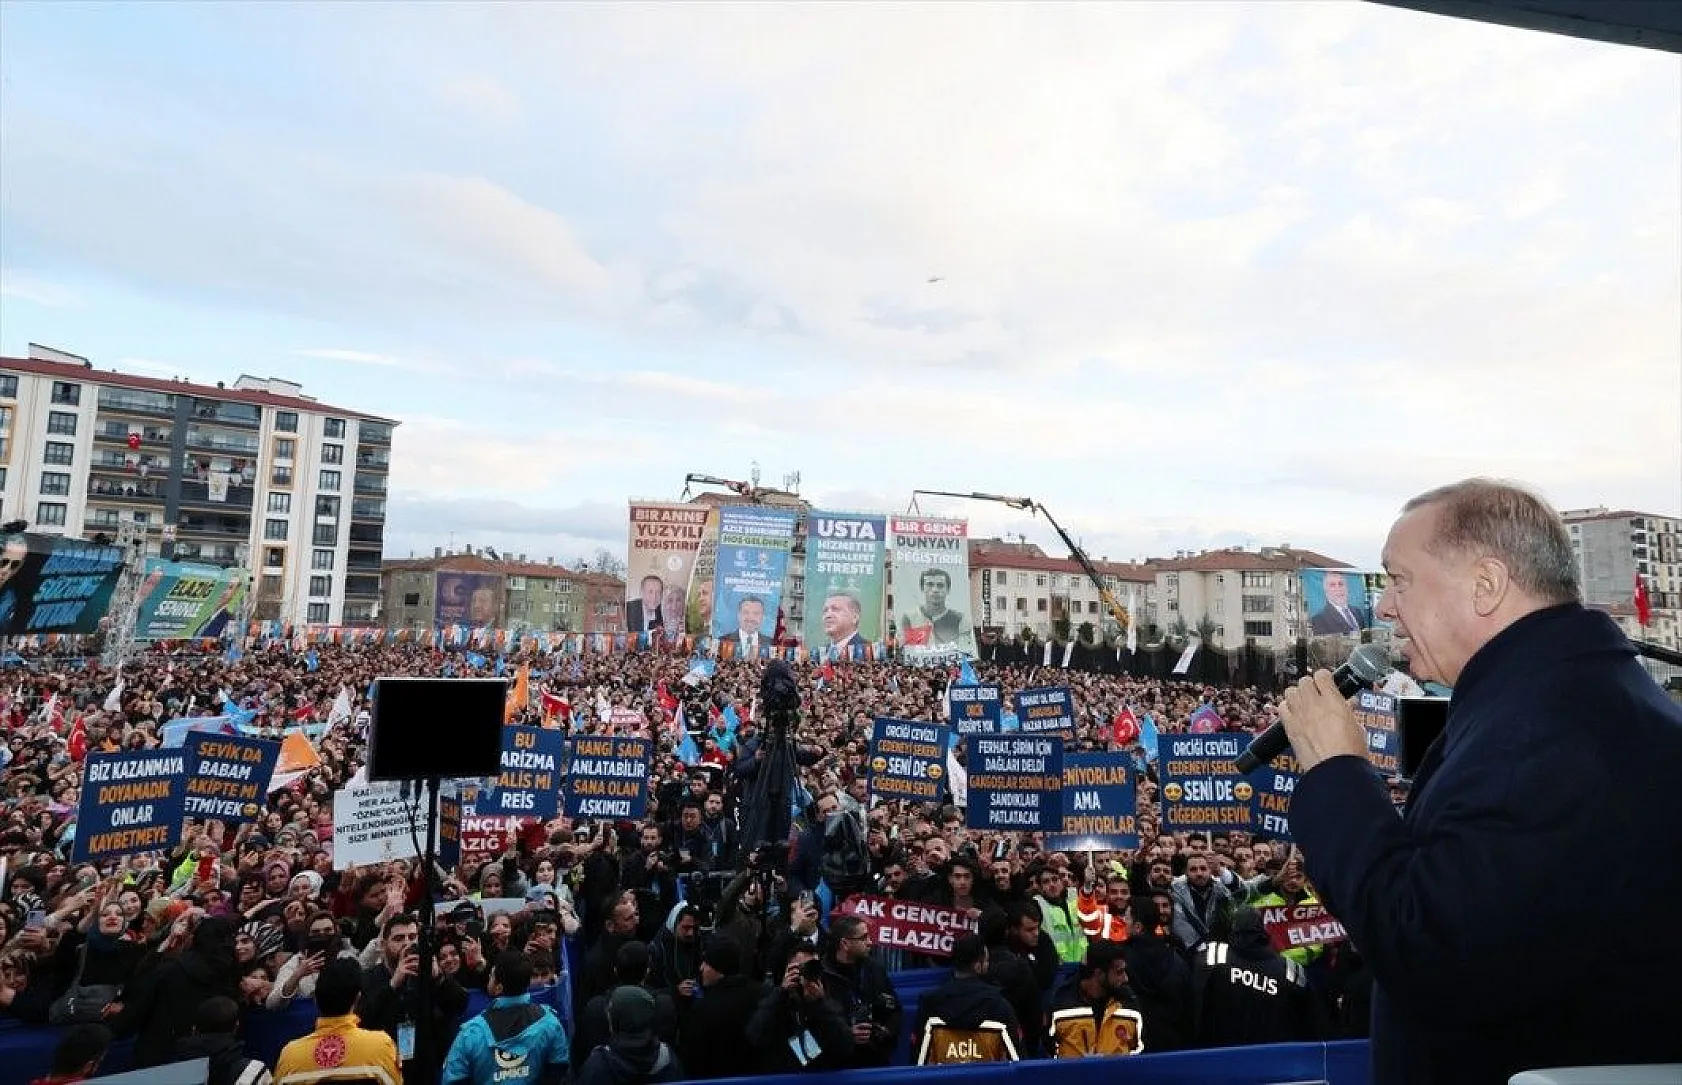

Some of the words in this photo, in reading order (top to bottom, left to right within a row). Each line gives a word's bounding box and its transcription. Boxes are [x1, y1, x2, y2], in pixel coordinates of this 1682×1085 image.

[661, 510, 705, 523] ANNE
[817, 518, 876, 540] USTA
[923, 522, 962, 536] GENÇ
[515, 732, 536, 748] BU
[576, 739, 613, 756] HANGİ
[1035, 738, 1053, 757] İÇİN
[242, 745, 262, 763] DA
[500, 749, 555, 771] ARİZMA
[89, 760, 112, 782] BİZ
[112, 755, 185, 779] KAZANMAYA
[198, 760, 251, 780] BABAM
[571, 758, 645, 777] ANLATABİLİR
[887, 755, 912, 775] SENİ
[912, 759, 928, 778] DE
[984, 755, 1020, 773] DAĞLARI
[1021, 756, 1045, 773] DELDİ
[534, 771, 552, 790] Mİ
[1063, 764, 1126, 786] ENİYORLAR
[1273, 774, 1299, 792] BA
[99, 780, 170, 804] DOYAMADIK
[186, 777, 240, 797] AKİPTE
[573, 779, 606, 795] SANA
[608, 781, 640, 798] OLAN
[1184, 777, 1213, 801] SENİ
[1215, 780, 1234, 801] DE
[501, 790, 535, 809] REİS
[578, 798, 631, 817] AŞKIMIZI
[989, 793, 1040, 807] SANDIKLARI
[1073, 790, 1102, 810] AMA
[110, 804, 153, 827] ONLAR
[988, 810, 1041, 825] PATLATACAK
[89, 826, 169, 853] KAYBETMEYE
[854, 898, 887, 919] AK
[1263, 907, 1288, 925] AK
[878, 926, 955, 952] ELAZIĞ
[945, 1038, 982, 1059] ACİL
